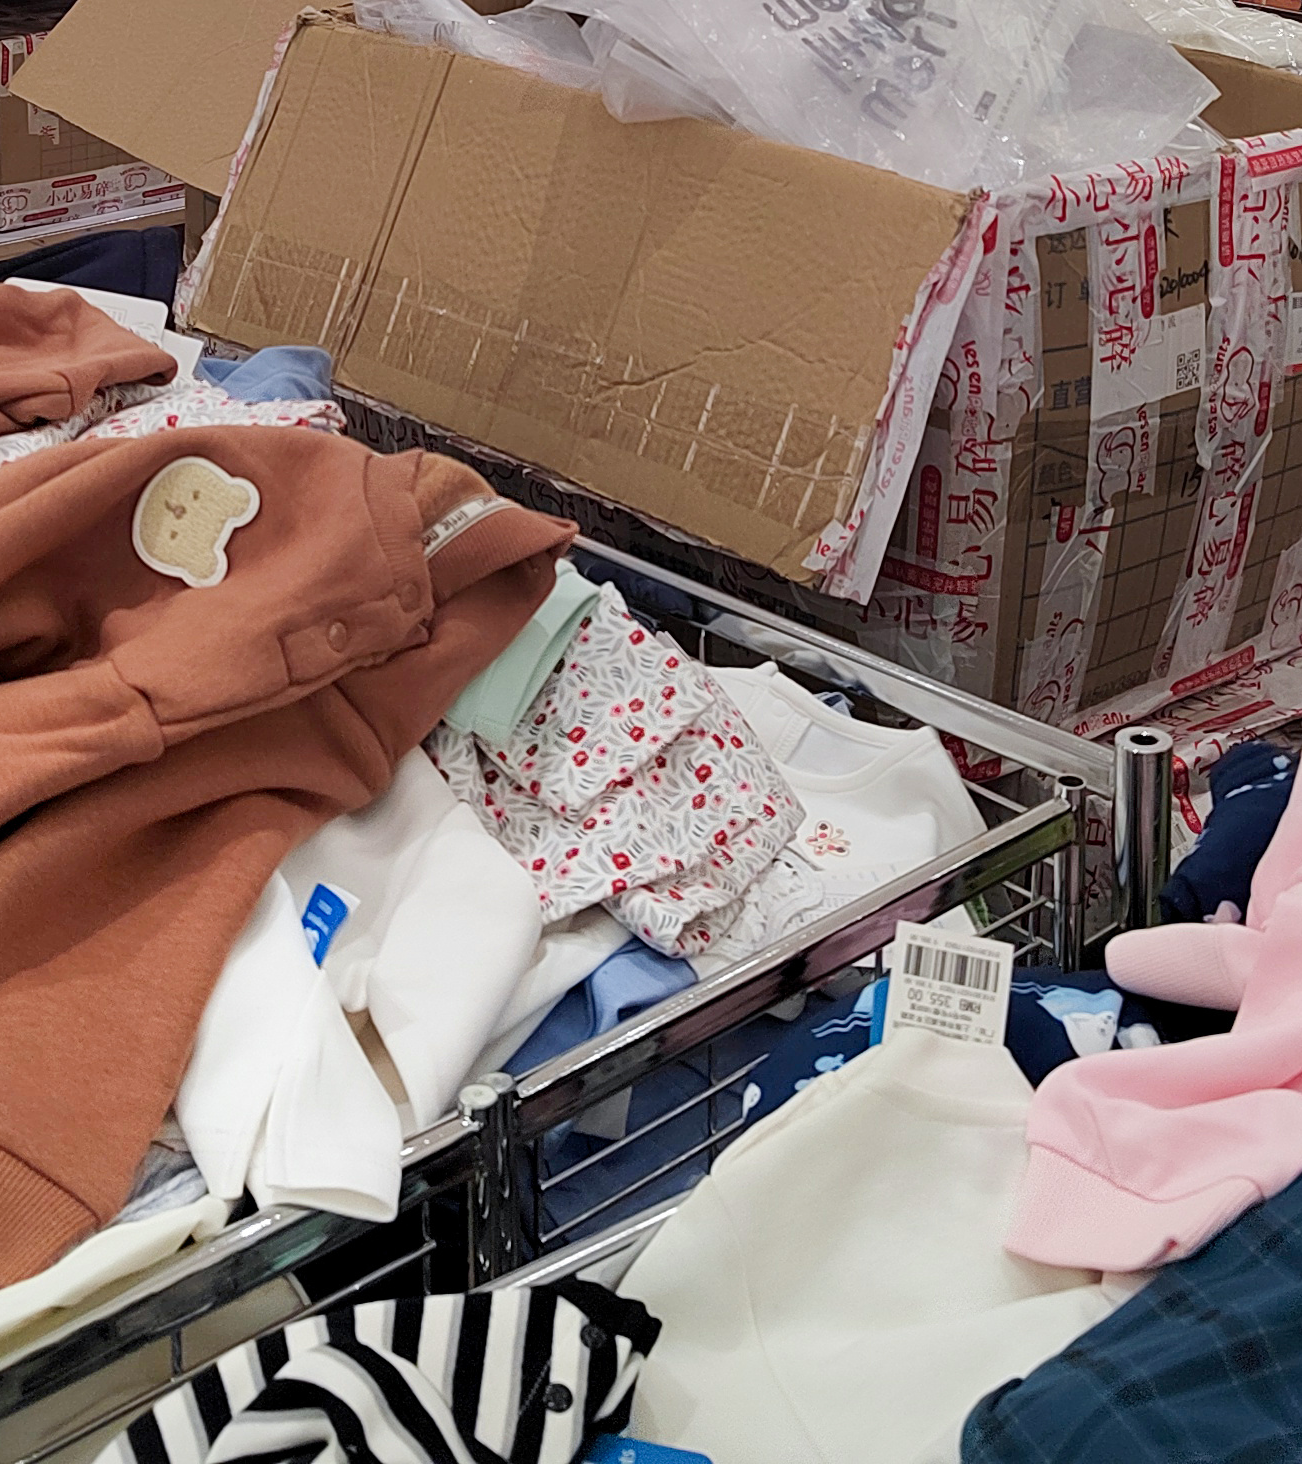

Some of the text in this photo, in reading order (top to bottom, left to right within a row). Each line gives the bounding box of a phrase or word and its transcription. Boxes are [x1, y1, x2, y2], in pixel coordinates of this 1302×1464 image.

[46, 183, 110, 207] 小心易碎
[1045, 155, 1190, 223] 小心易碎
[961, 339, 980, 370] les
[959, 998, 981, 1014] RMB
